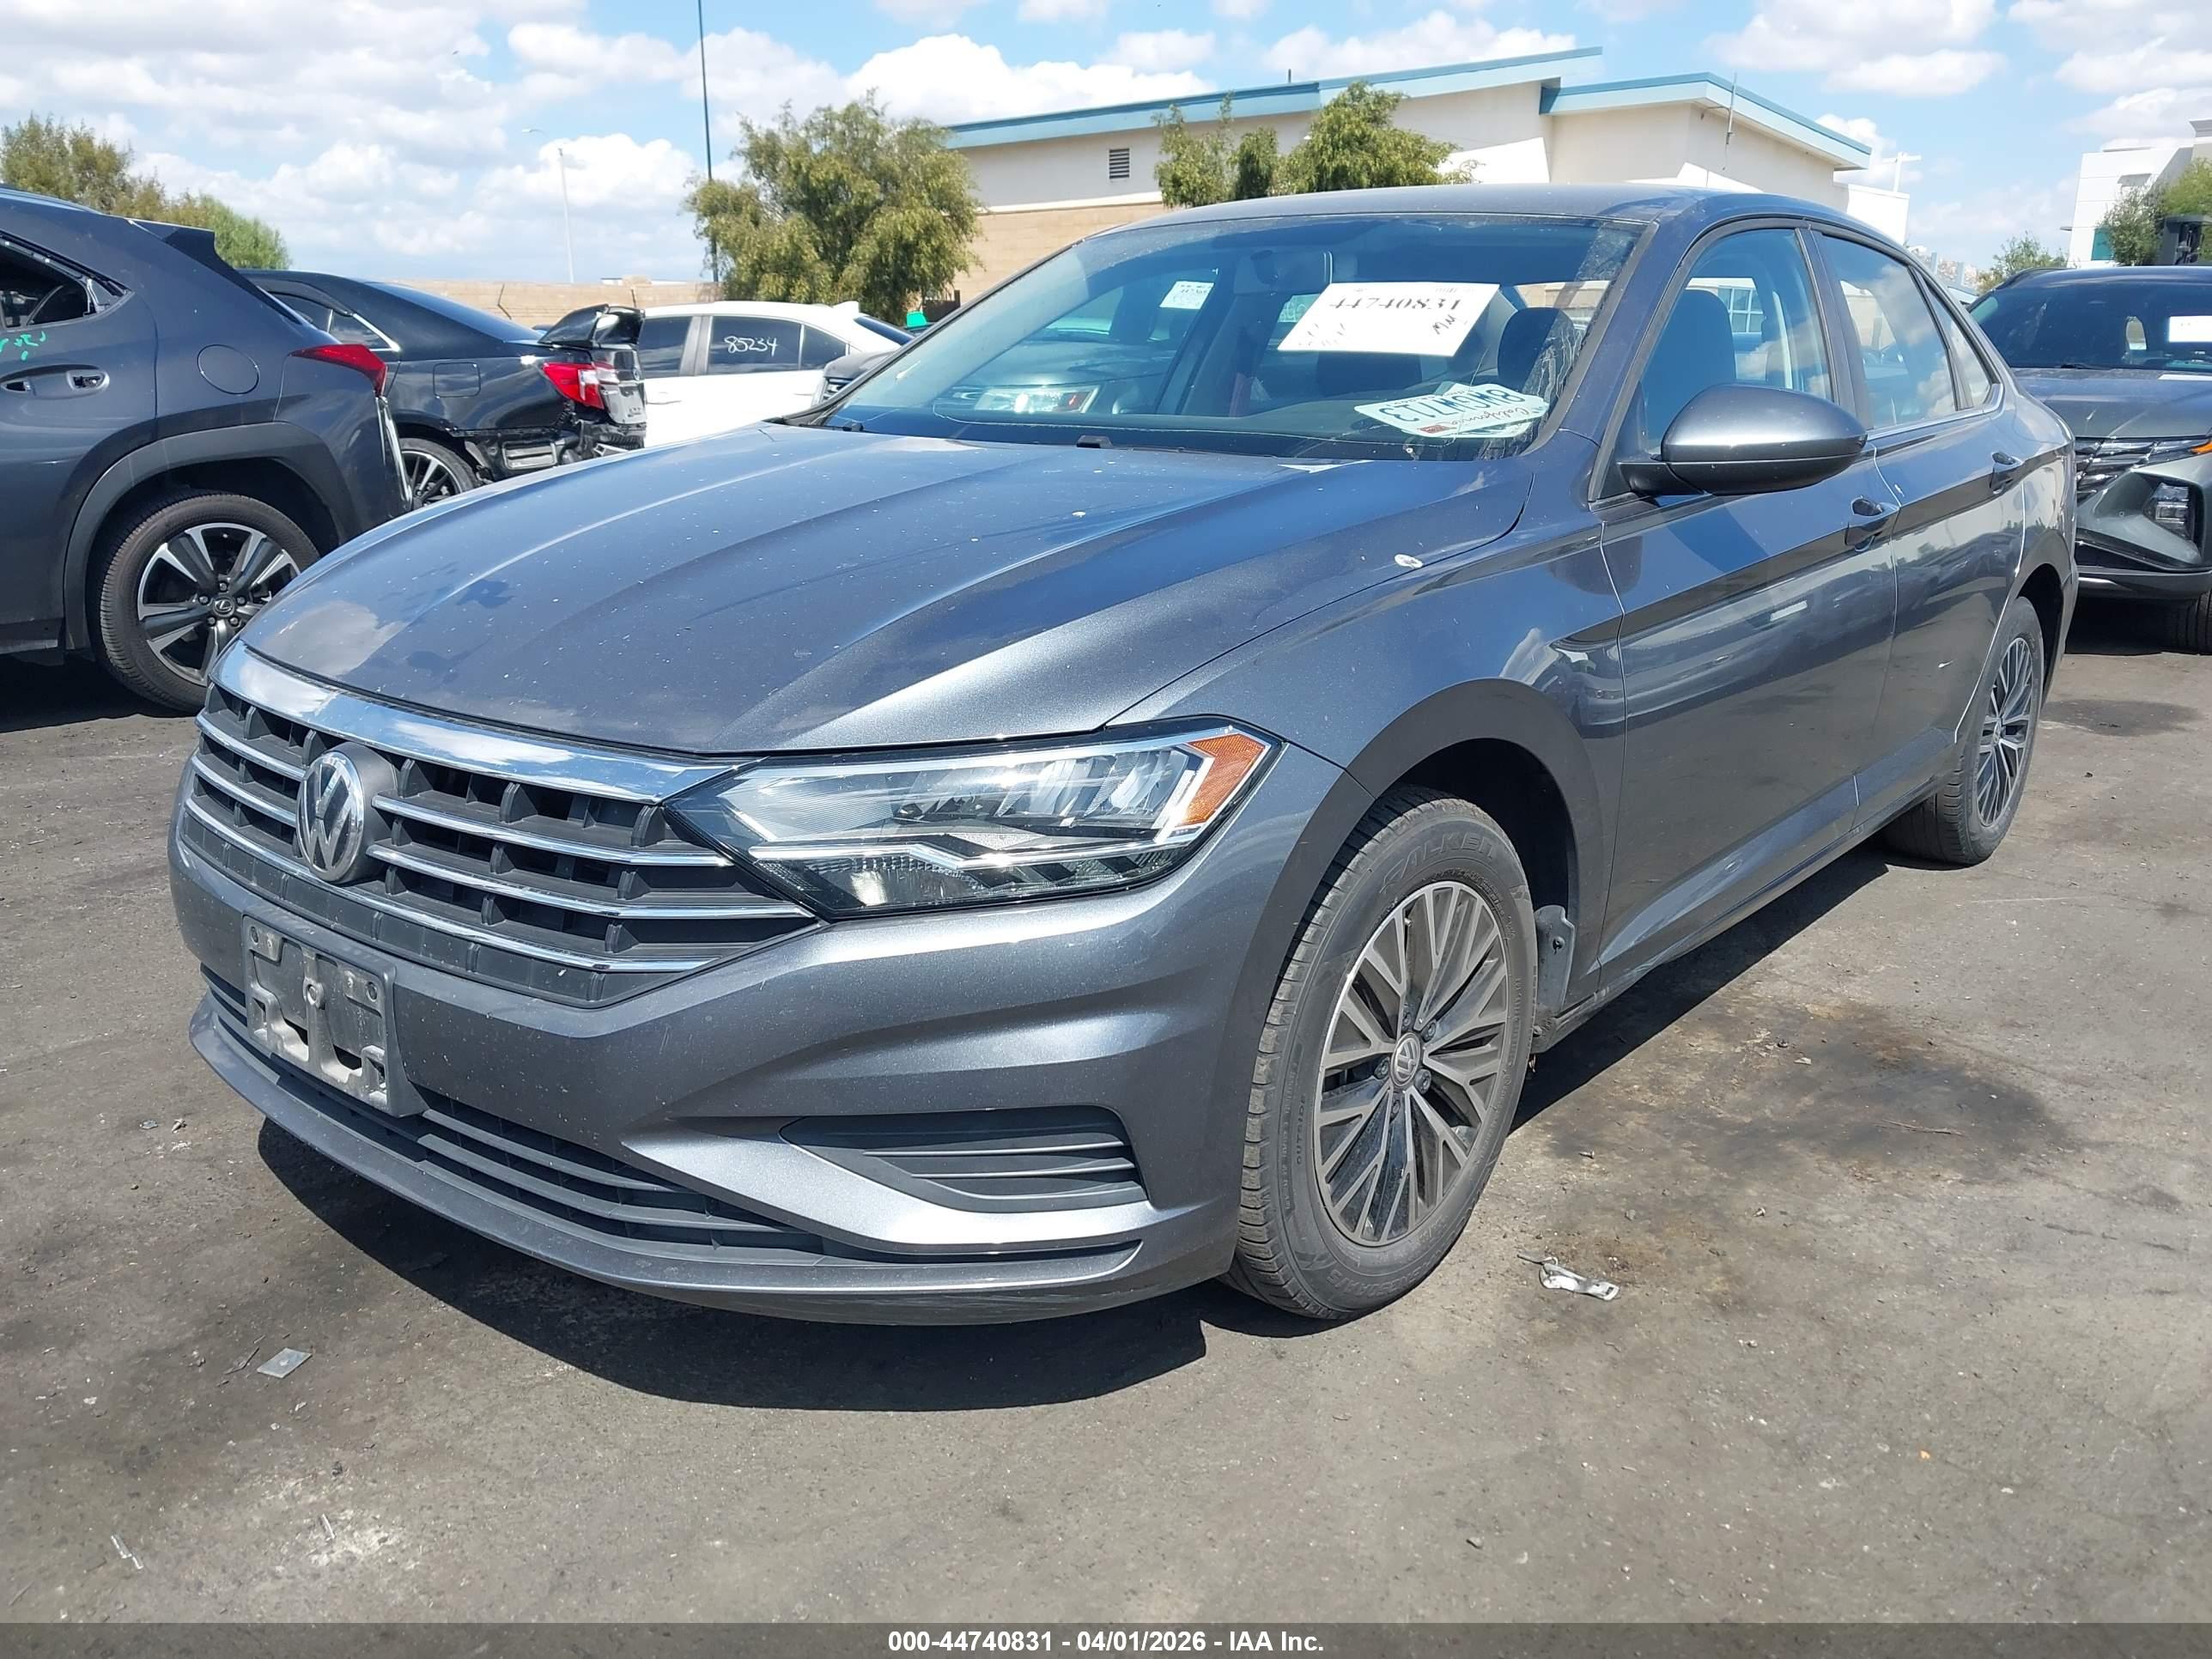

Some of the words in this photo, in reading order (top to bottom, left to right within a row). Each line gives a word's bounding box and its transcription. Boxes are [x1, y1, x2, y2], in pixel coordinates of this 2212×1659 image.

[1328, 296, 1462, 311] 44740831
[1378, 389, 1526, 422] 8WGW713
[1449, 406, 1530, 426] California
[1379, 830, 1495, 895] FALKEN
